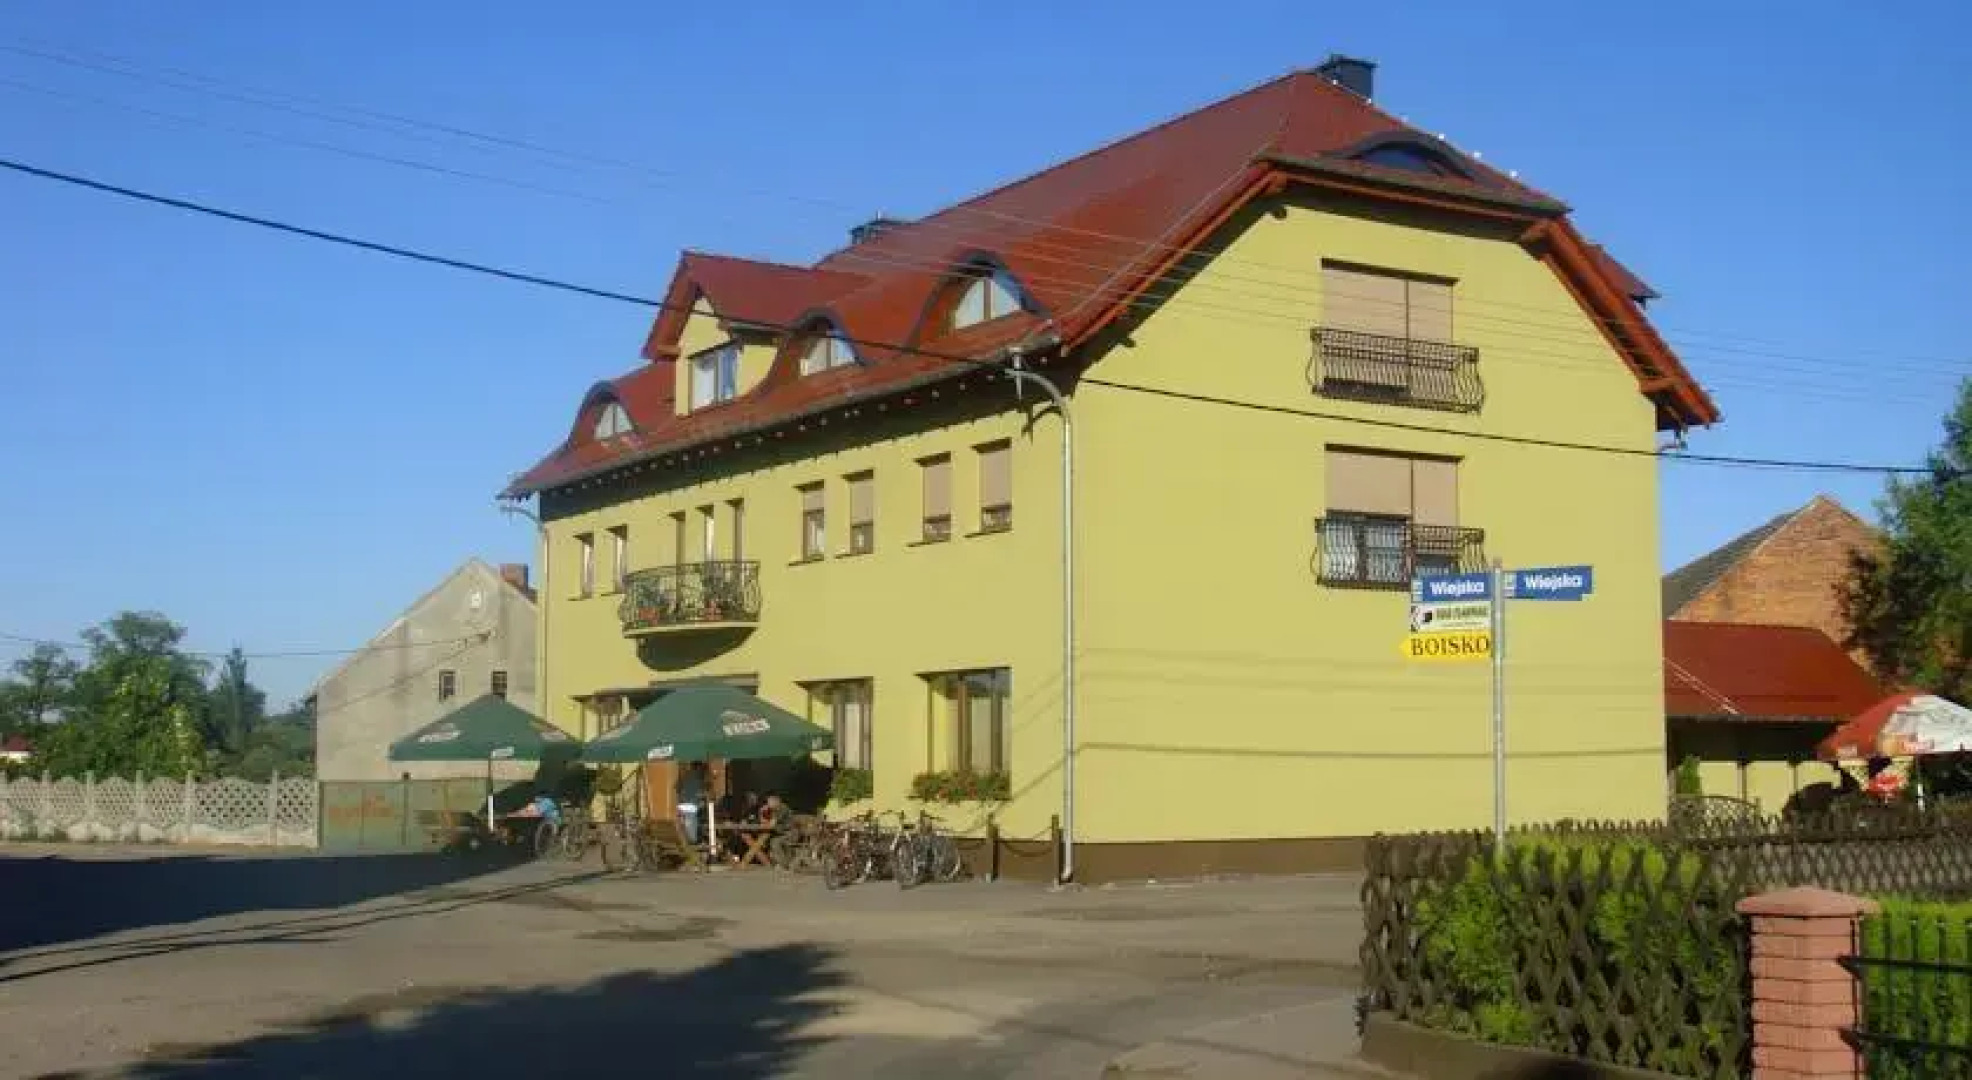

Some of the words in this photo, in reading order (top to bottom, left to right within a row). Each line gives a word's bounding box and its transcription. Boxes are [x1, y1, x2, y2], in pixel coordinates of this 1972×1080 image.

[1429, 580, 1485, 597] Wiejska
[1523, 573, 1583, 592] Wiejska
[1410, 635, 1489, 656] BOISKO
